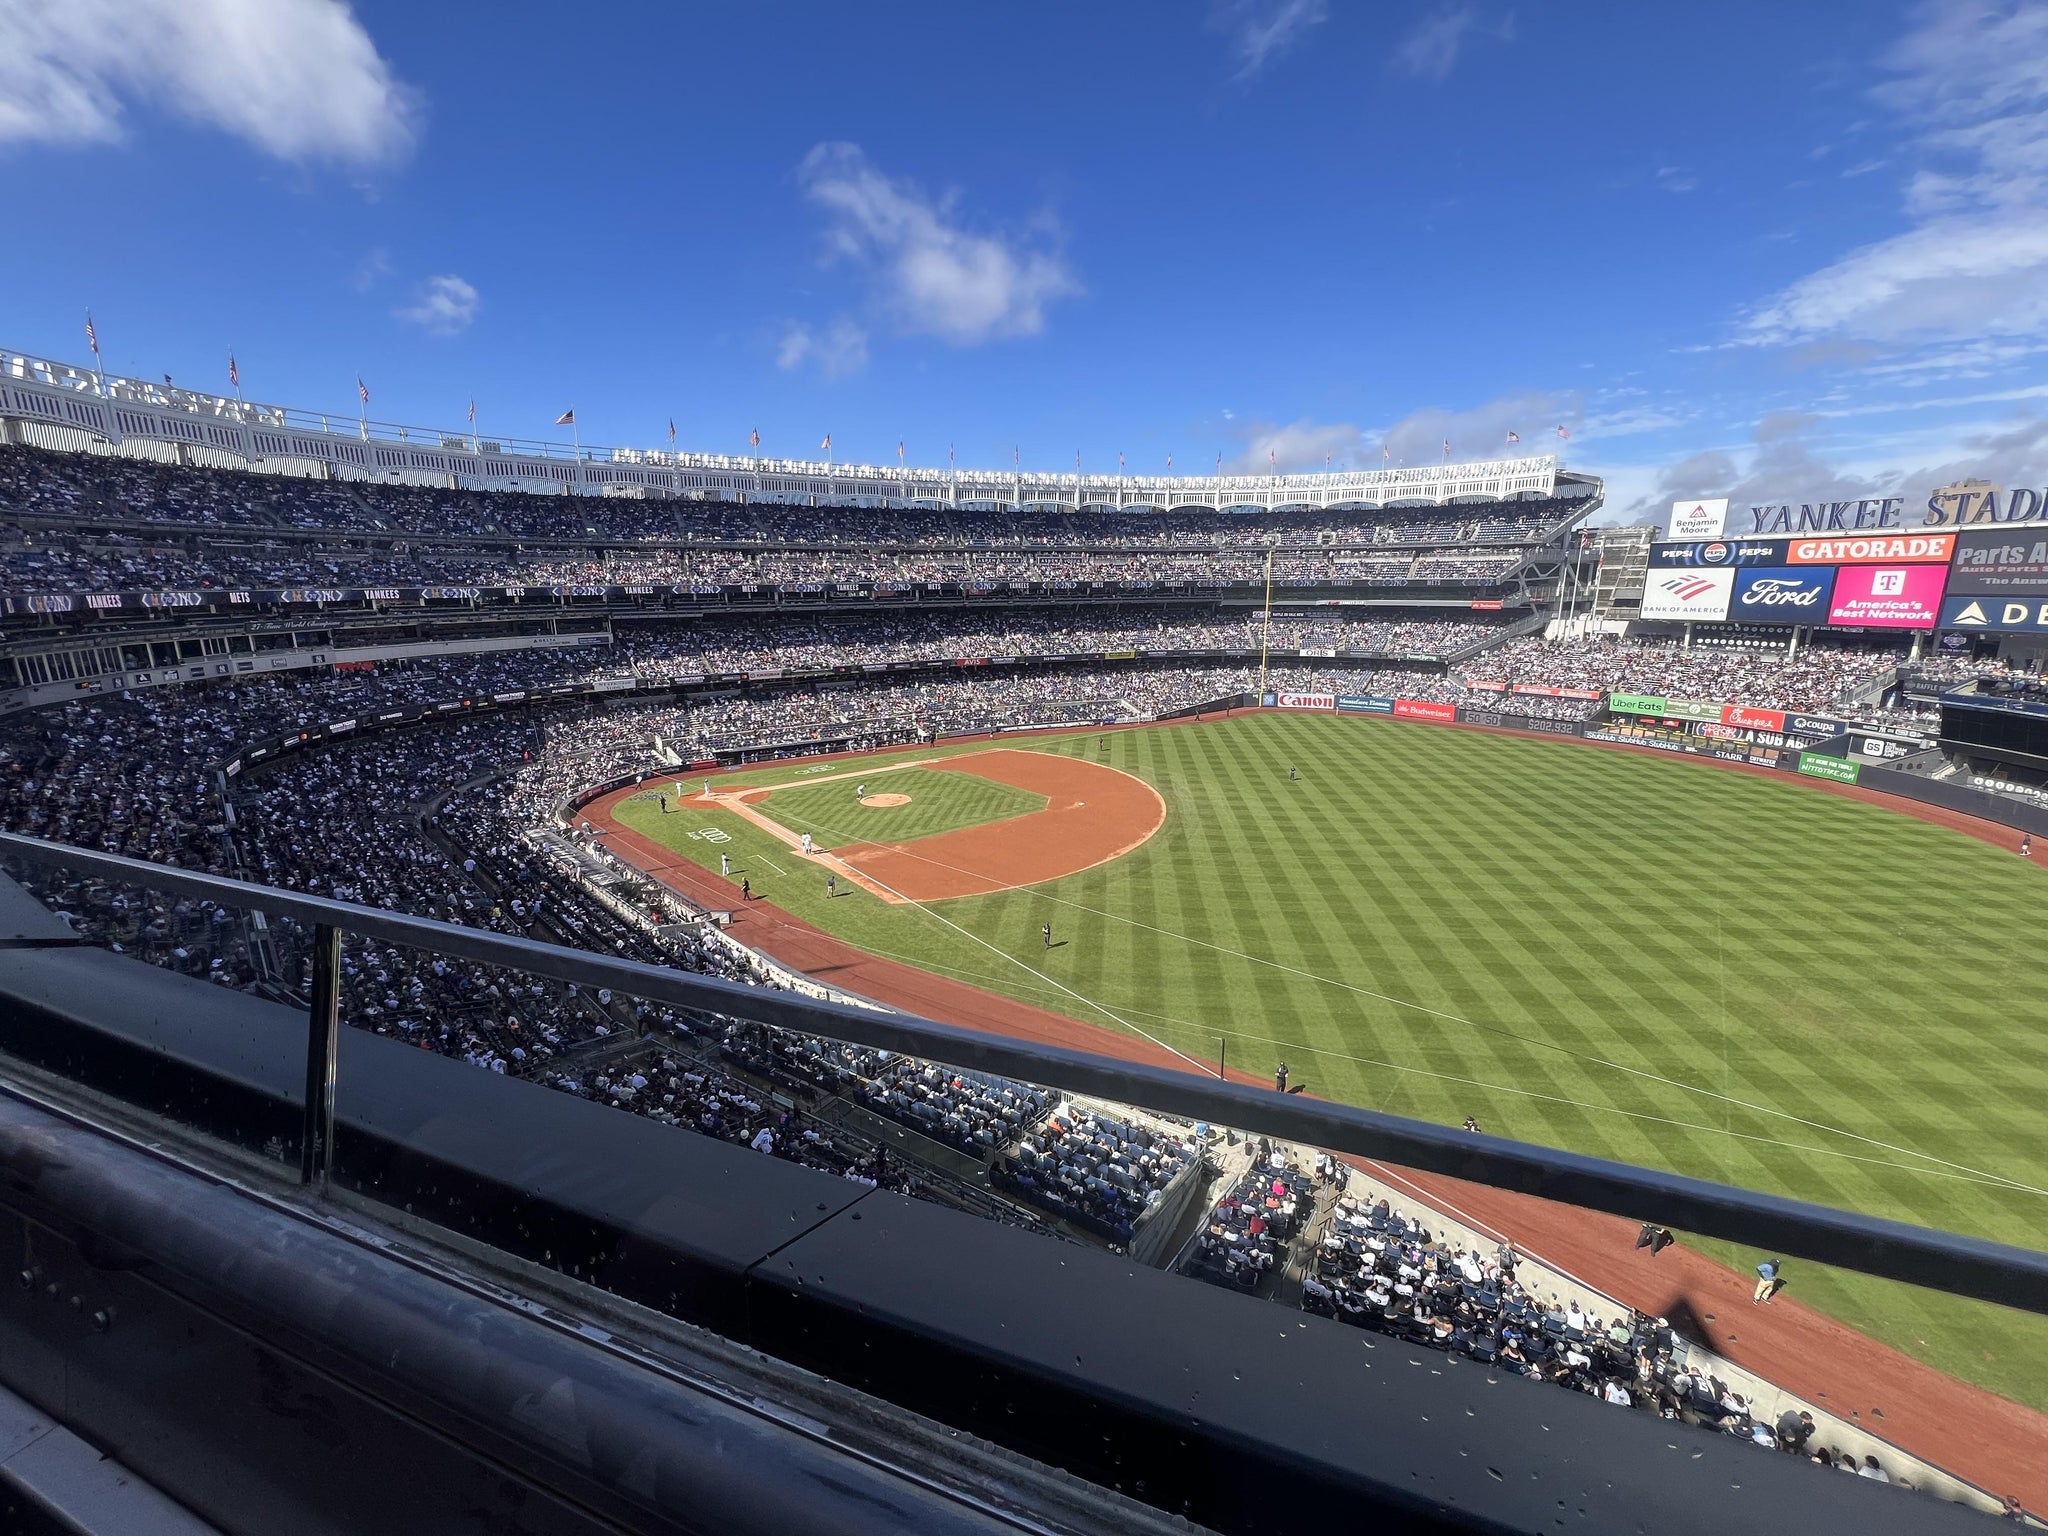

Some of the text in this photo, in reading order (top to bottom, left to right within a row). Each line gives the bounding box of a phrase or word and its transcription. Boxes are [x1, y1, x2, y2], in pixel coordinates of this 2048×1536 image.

[1752, 498, 1904, 534] YANKEE
[1676, 518, 1718, 528] Benjamin
[1662, 550, 1693, 558] PEPSI
[1739, 547, 1773, 556] PEPSI
[1797, 538, 1946, 560] GATORADE
[1957, 542, 2048, 565] Parts A
[837, 584, 859, 592] YANKEES
[928, 582, 941, 590] METS
[1009, 582, 1029, 590] YANKEES
[1164, 580, 1184, 588] YANKEES
[1331, 579, 1353, 587] YANKEES
[506, 587, 525, 597] METS
[624, 586, 654, 594] YANKEES
[742, 585, 758, 593] METS
[1741, 579, 1822, 606] Ford
[229, 592, 250, 603] METS
[364, 589, 400, 600] YANKEES
[86, 594, 122, 609] YANKEES
[1846, 600, 1922, 610] America's
[1683, 606, 1725, 614] AMERICA
[1832, 609, 1933, 621] Best Network
[284, 621, 307, 630] World
[965, 657, 981, 665] AVIS
[1916, 683, 1938, 691] RAFFLE
[1279, 694, 1333, 708] Canon
[1612, 698, 1636, 709] Uber
[1638, 702, 1662, 713] Eats
[1410, 706, 1451, 719] Budweiser
[1468, 713, 1498, 726] 50 50
[1528, 718, 1573, 734] $202,932
[1806, 718, 1835, 733] coupa
[1587, 731, 1679, 751] StubHub StubHub StubHub
[1746, 730, 1754, 743] A
[1757, 732, 1783, 746] SUB
[1866, 743, 1880, 752] GS
[1715, 751, 1743, 761] STARR
[1800, 764, 1856, 781] NITTOTIRE.COM
